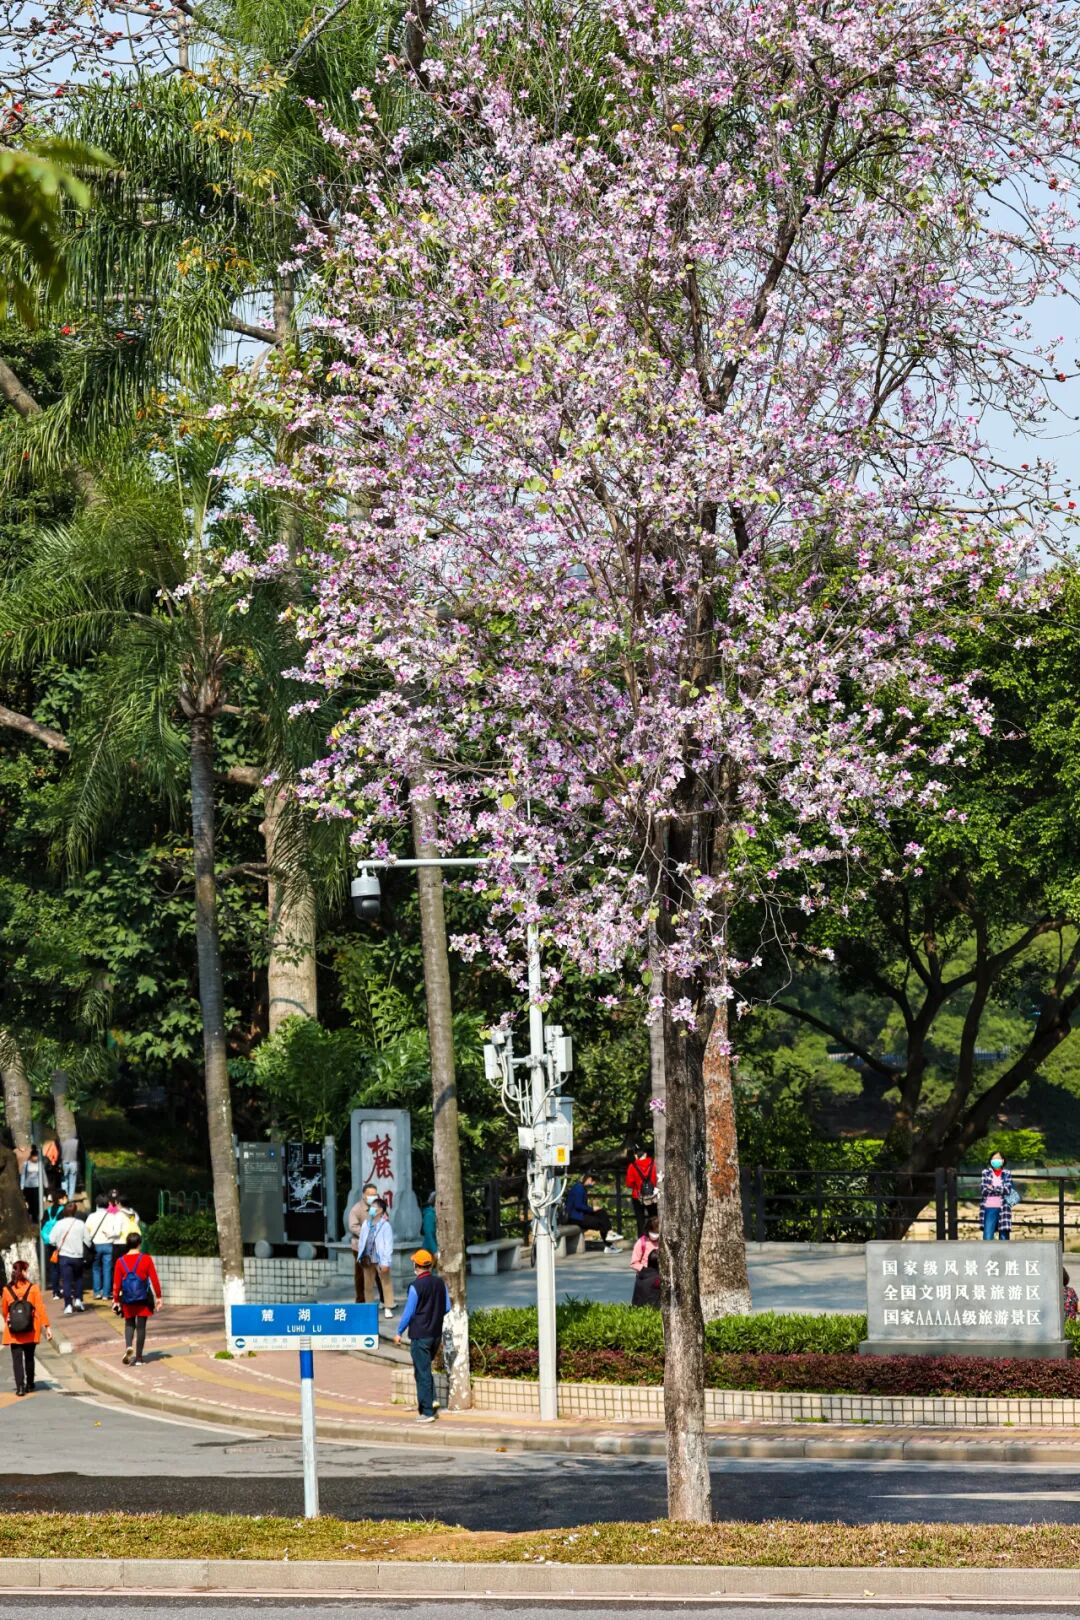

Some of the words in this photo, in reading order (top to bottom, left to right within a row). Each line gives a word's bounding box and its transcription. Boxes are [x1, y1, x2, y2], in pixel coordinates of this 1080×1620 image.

[882, 1260, 1041, 1276] 国家级风景名胜区
[883, 1284, 1041, 1301] 全国文明风景旅游区
[261, 1308, 347, 1322] 麓湖路
[883, 1309, 1042, 1326] 国家AAAAA级旅游景区
[287, 1325, 305, 1333] LUHU
[312, 1325, 322, 1333] LU
